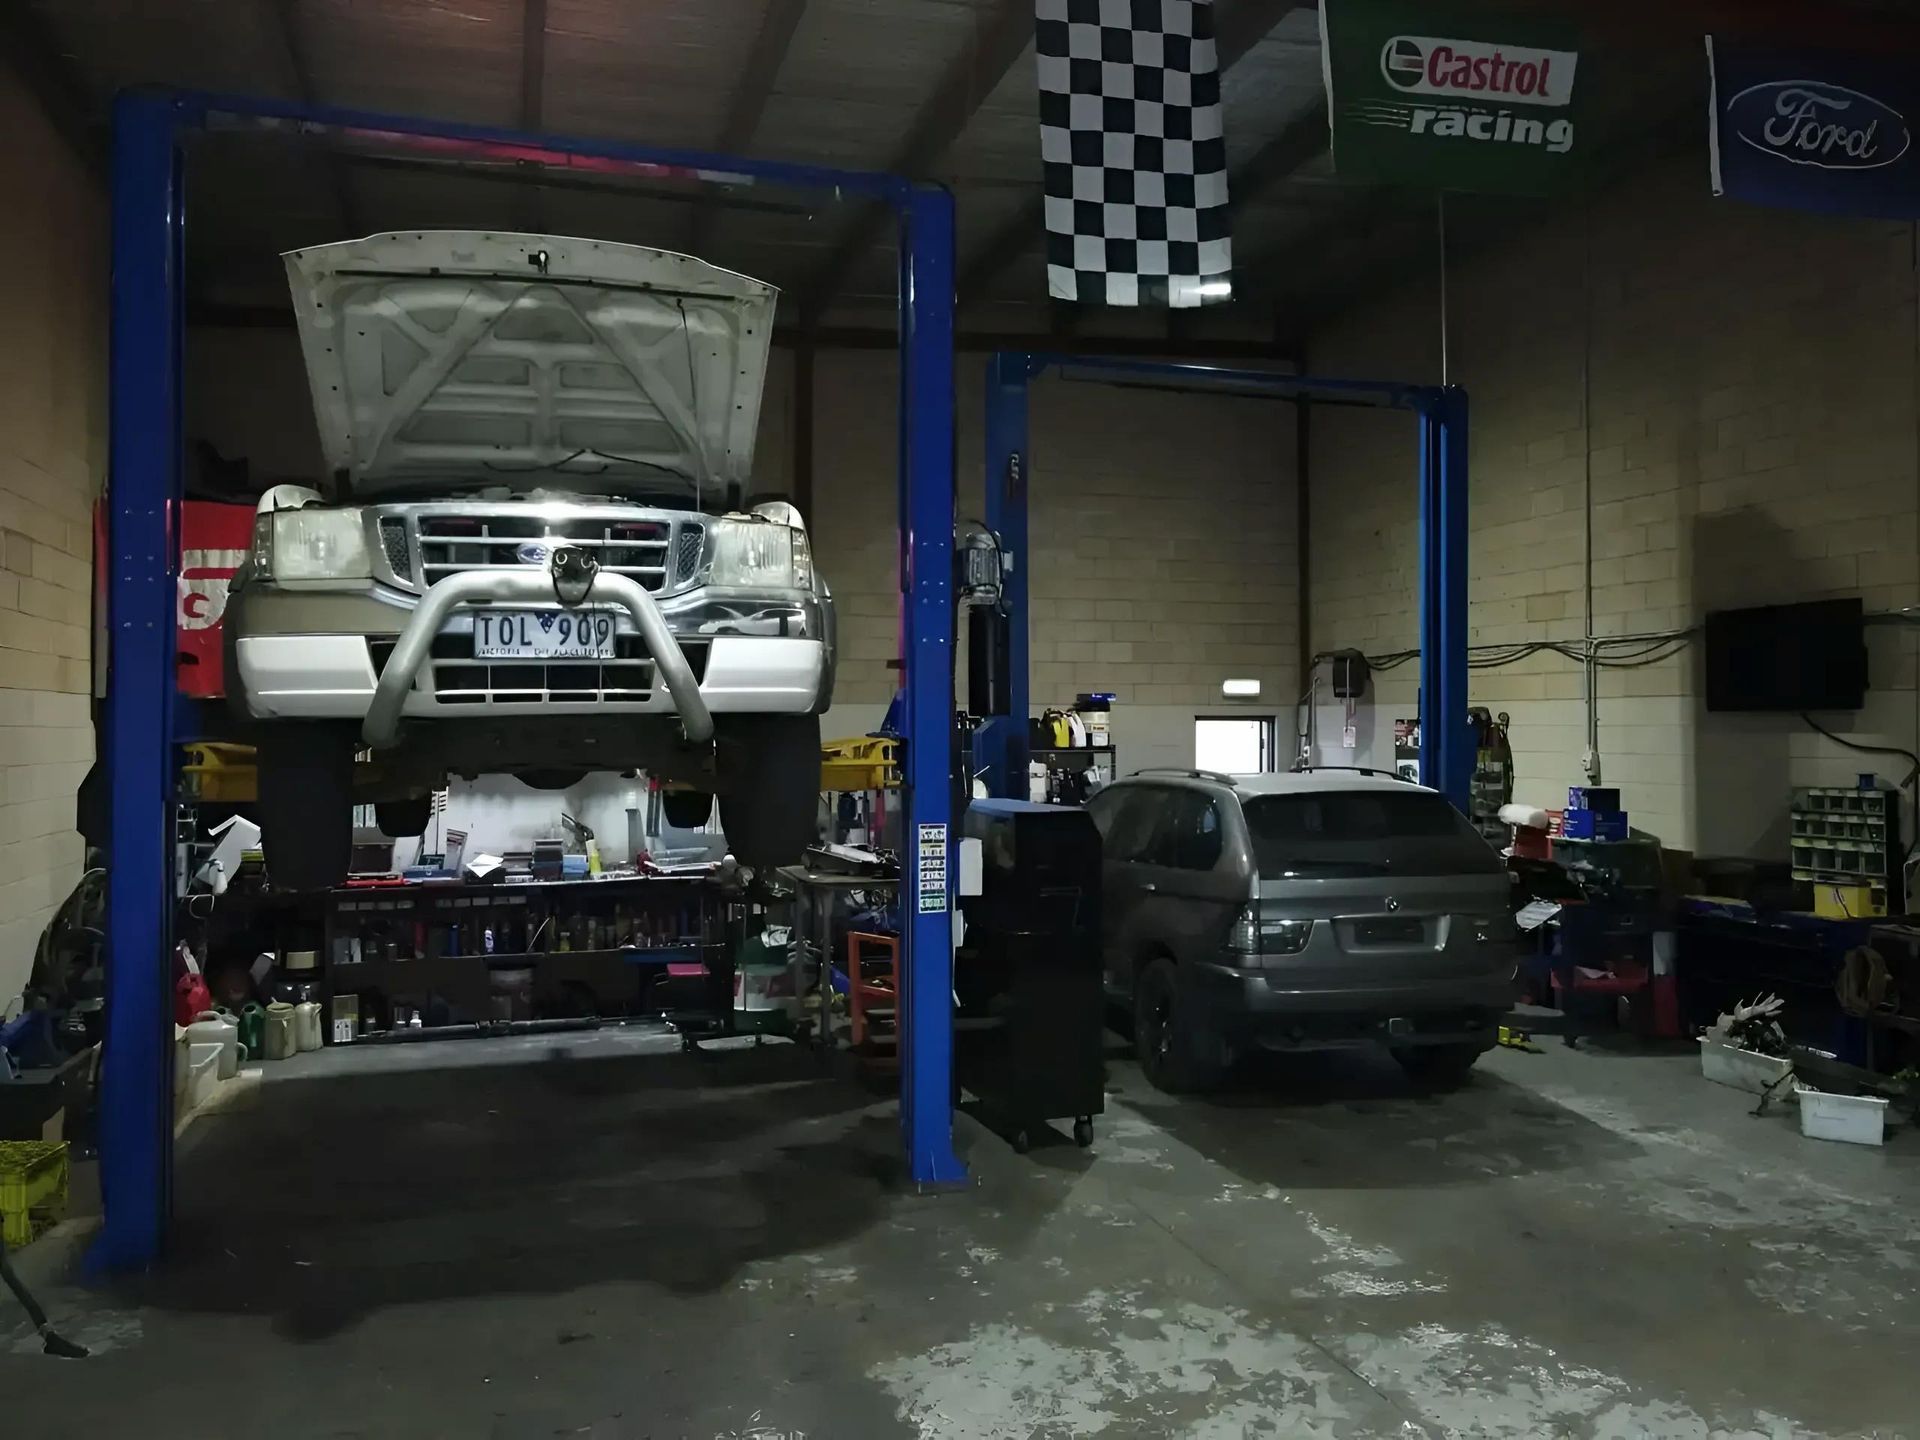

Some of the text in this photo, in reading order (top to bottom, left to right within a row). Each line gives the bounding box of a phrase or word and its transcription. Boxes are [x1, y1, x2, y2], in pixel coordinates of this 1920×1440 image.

[1428, 46, 1550, 97] Castrol
[1410, 107, 1574, 154] racing
[1763, 88, 1878, 159] Ford
[558, 617, 609, 647] 909
